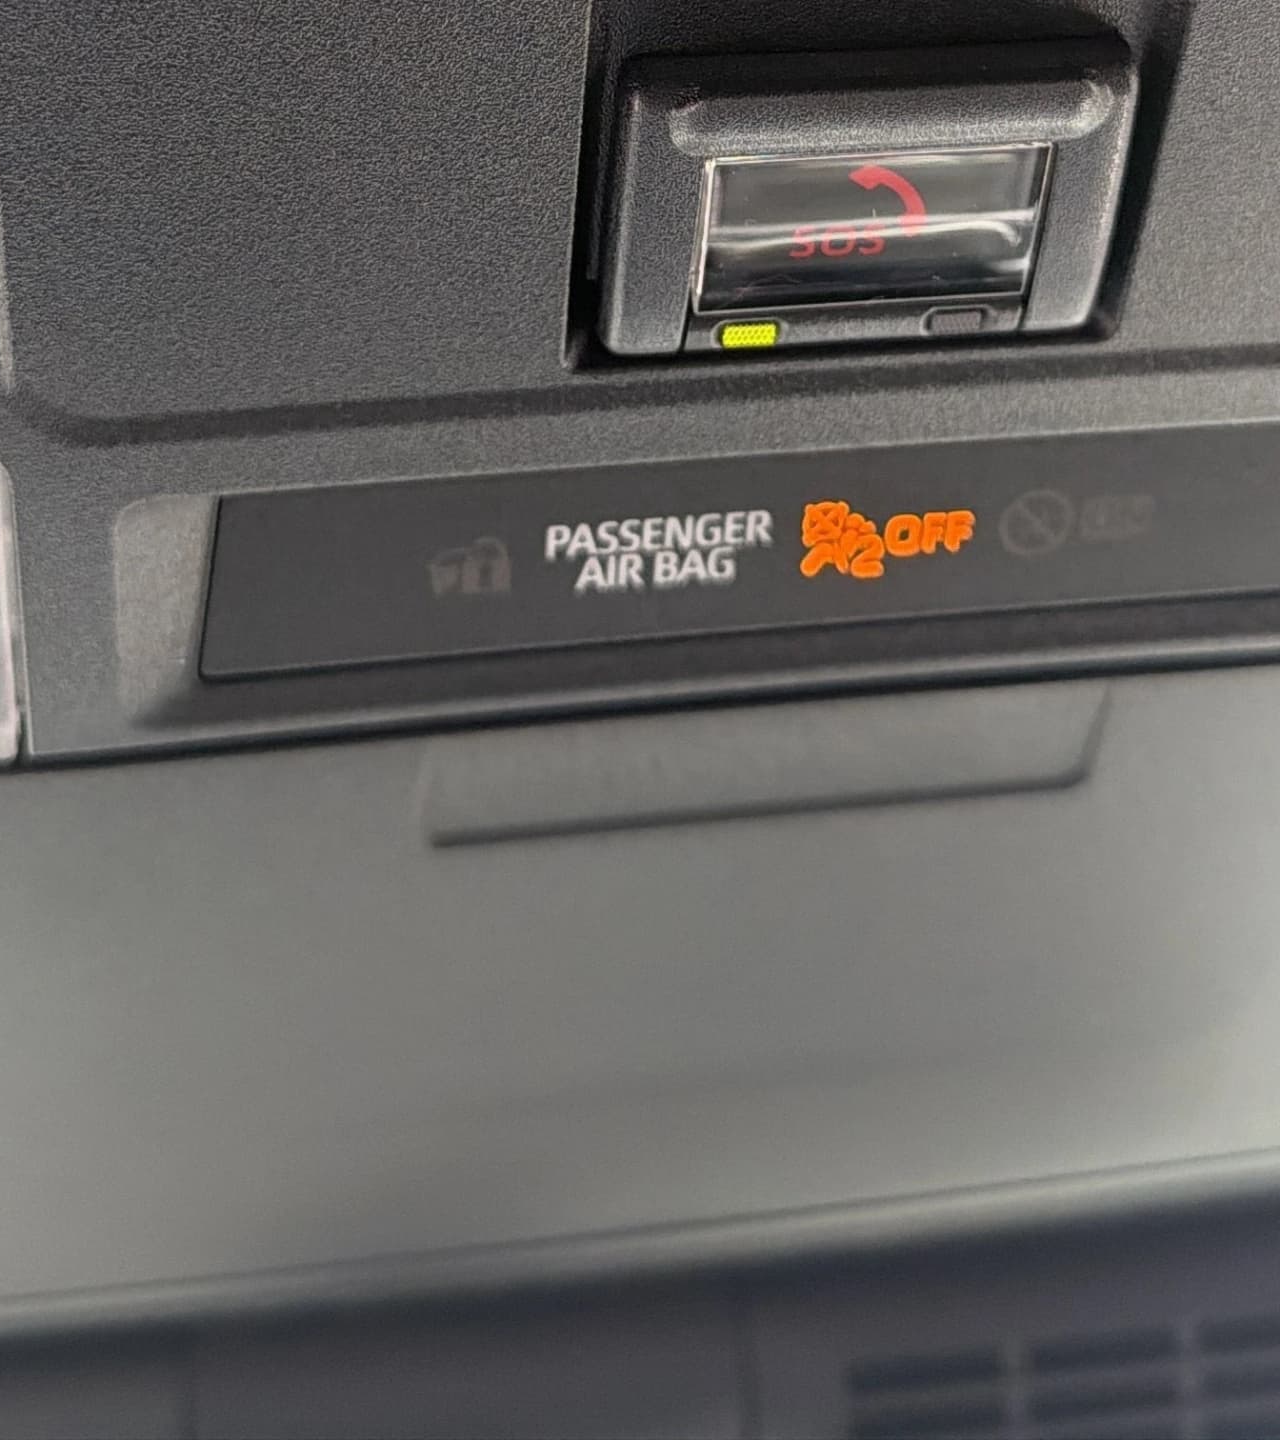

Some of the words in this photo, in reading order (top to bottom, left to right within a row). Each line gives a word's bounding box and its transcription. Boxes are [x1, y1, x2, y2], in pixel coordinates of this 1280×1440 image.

[789, 224, 885, 258] SOS
[544, 509, 773, 560] PASSENGER
[884, 509, 977, 558] OFF
[573, 553, 643, 593] AIR
[652, 546, 736, 586] BAG
